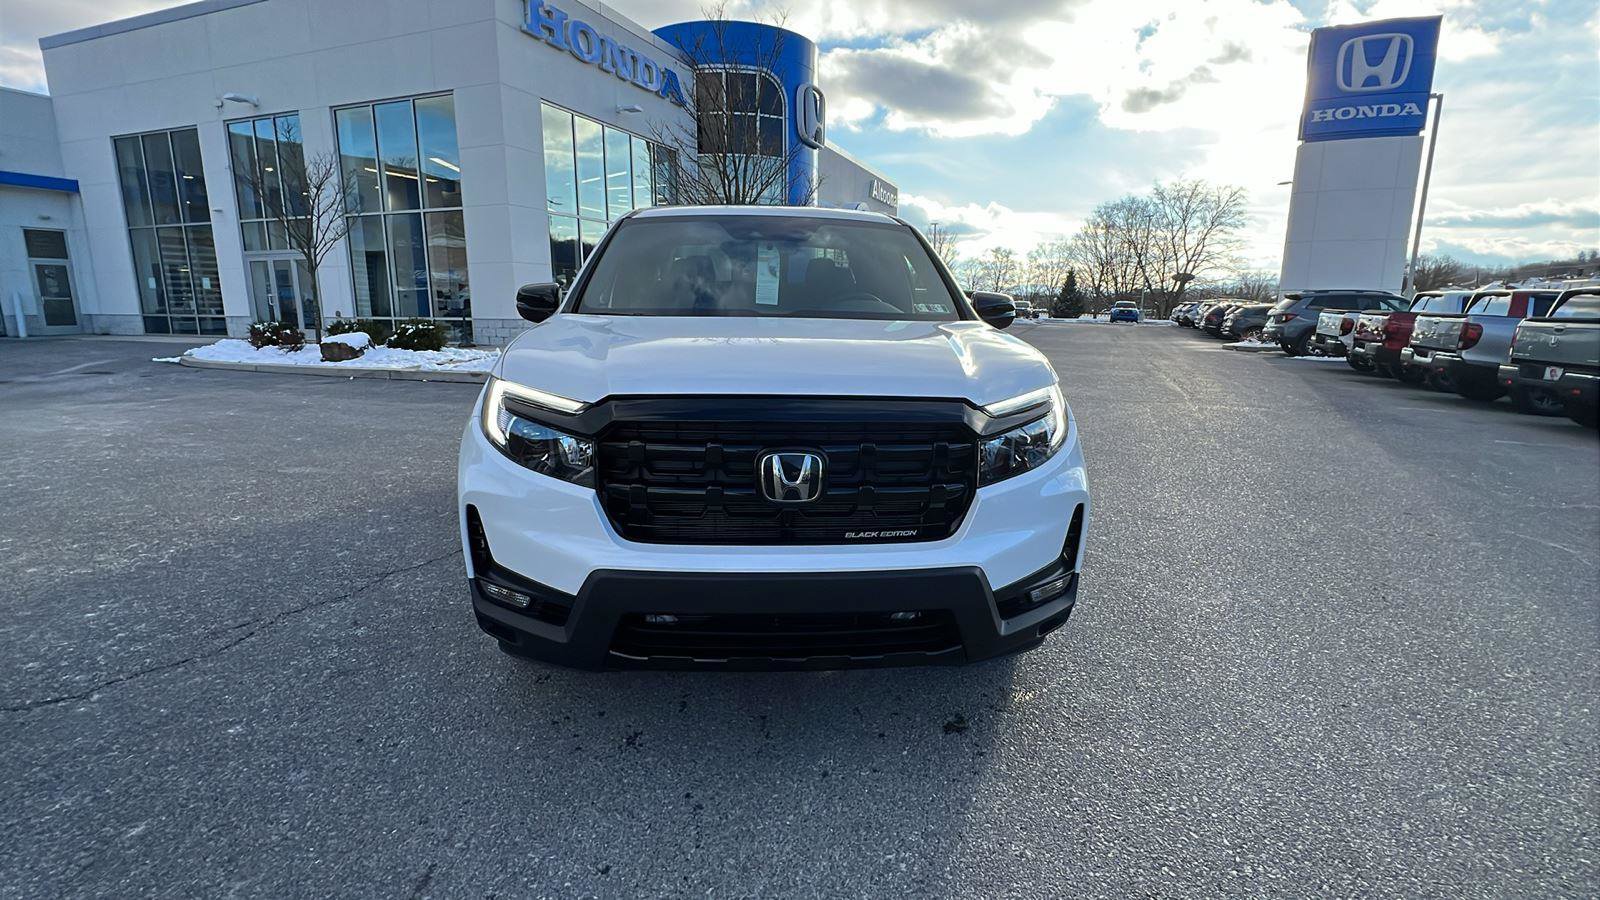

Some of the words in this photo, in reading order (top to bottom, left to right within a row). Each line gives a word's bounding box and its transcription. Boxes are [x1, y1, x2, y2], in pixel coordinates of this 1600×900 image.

[520, 0, 688, 107] HONDA
[1311, 103, 1422, 122] HONDA
[872, 179, 897, 208] Altoona
[880, 529, 918, 537] EDITION
